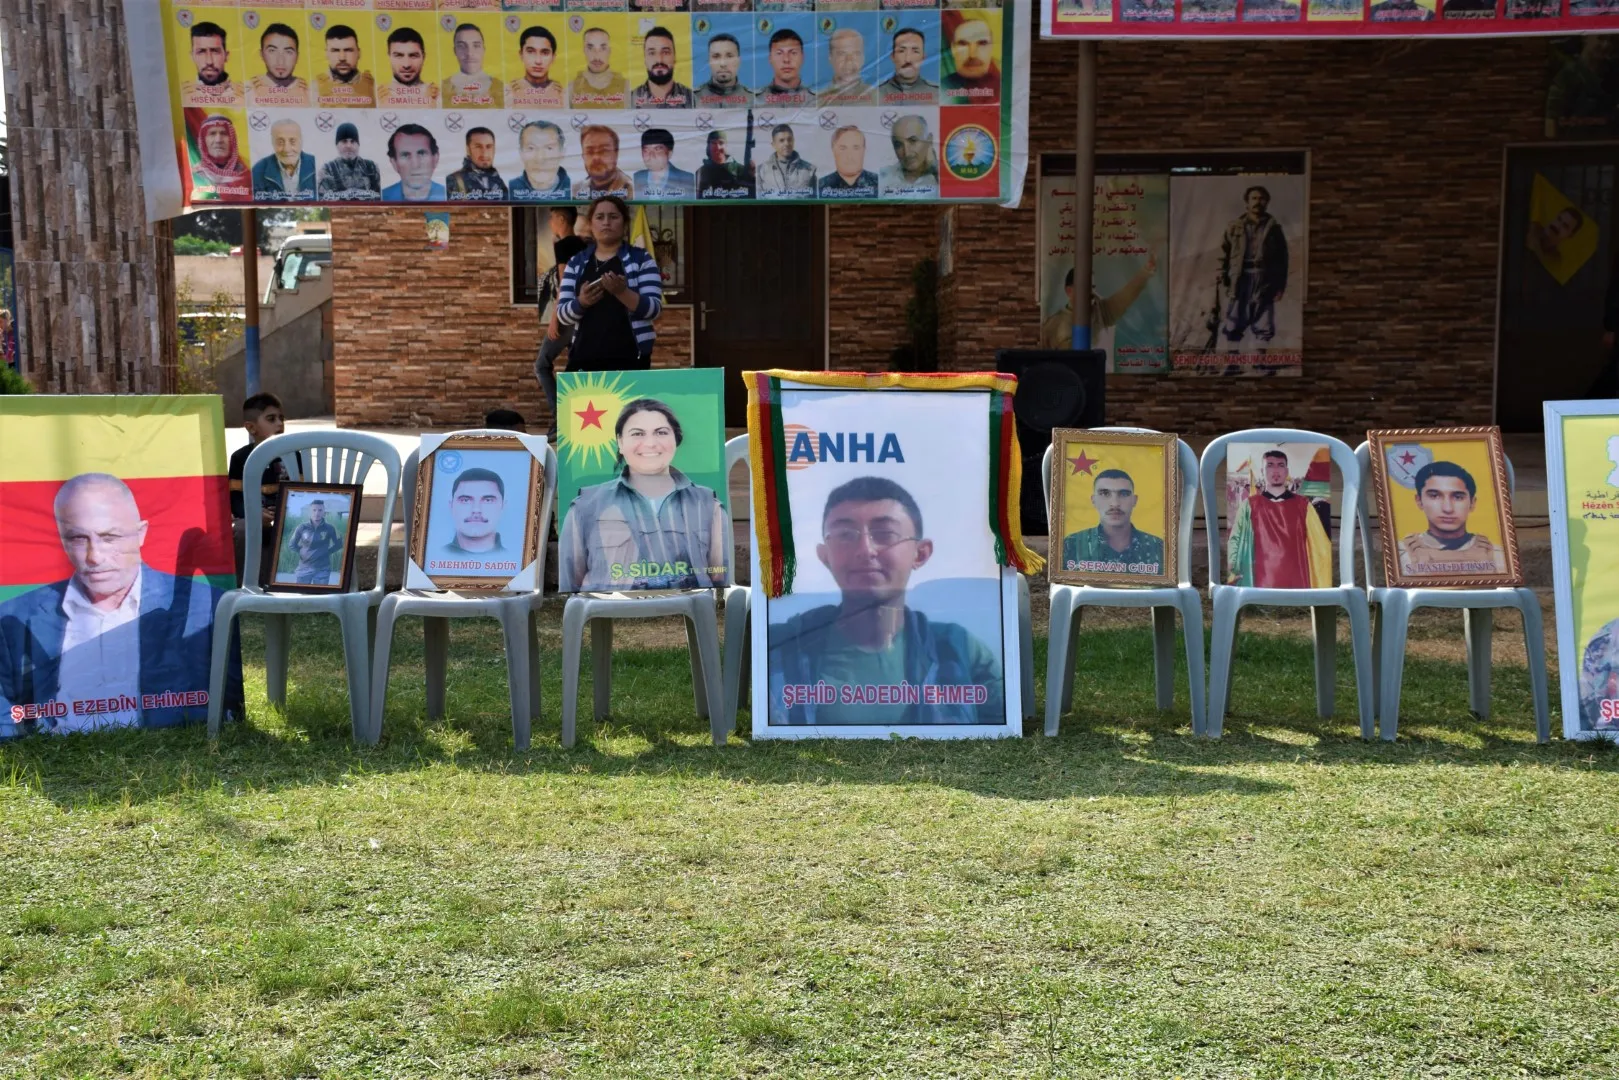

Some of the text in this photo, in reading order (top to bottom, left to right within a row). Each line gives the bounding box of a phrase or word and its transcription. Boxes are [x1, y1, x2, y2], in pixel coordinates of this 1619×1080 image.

[788, 431, 906, 463] ANHA
[782, 680, 988, 709] ŞEHÎD SADEDÎN EHMED
